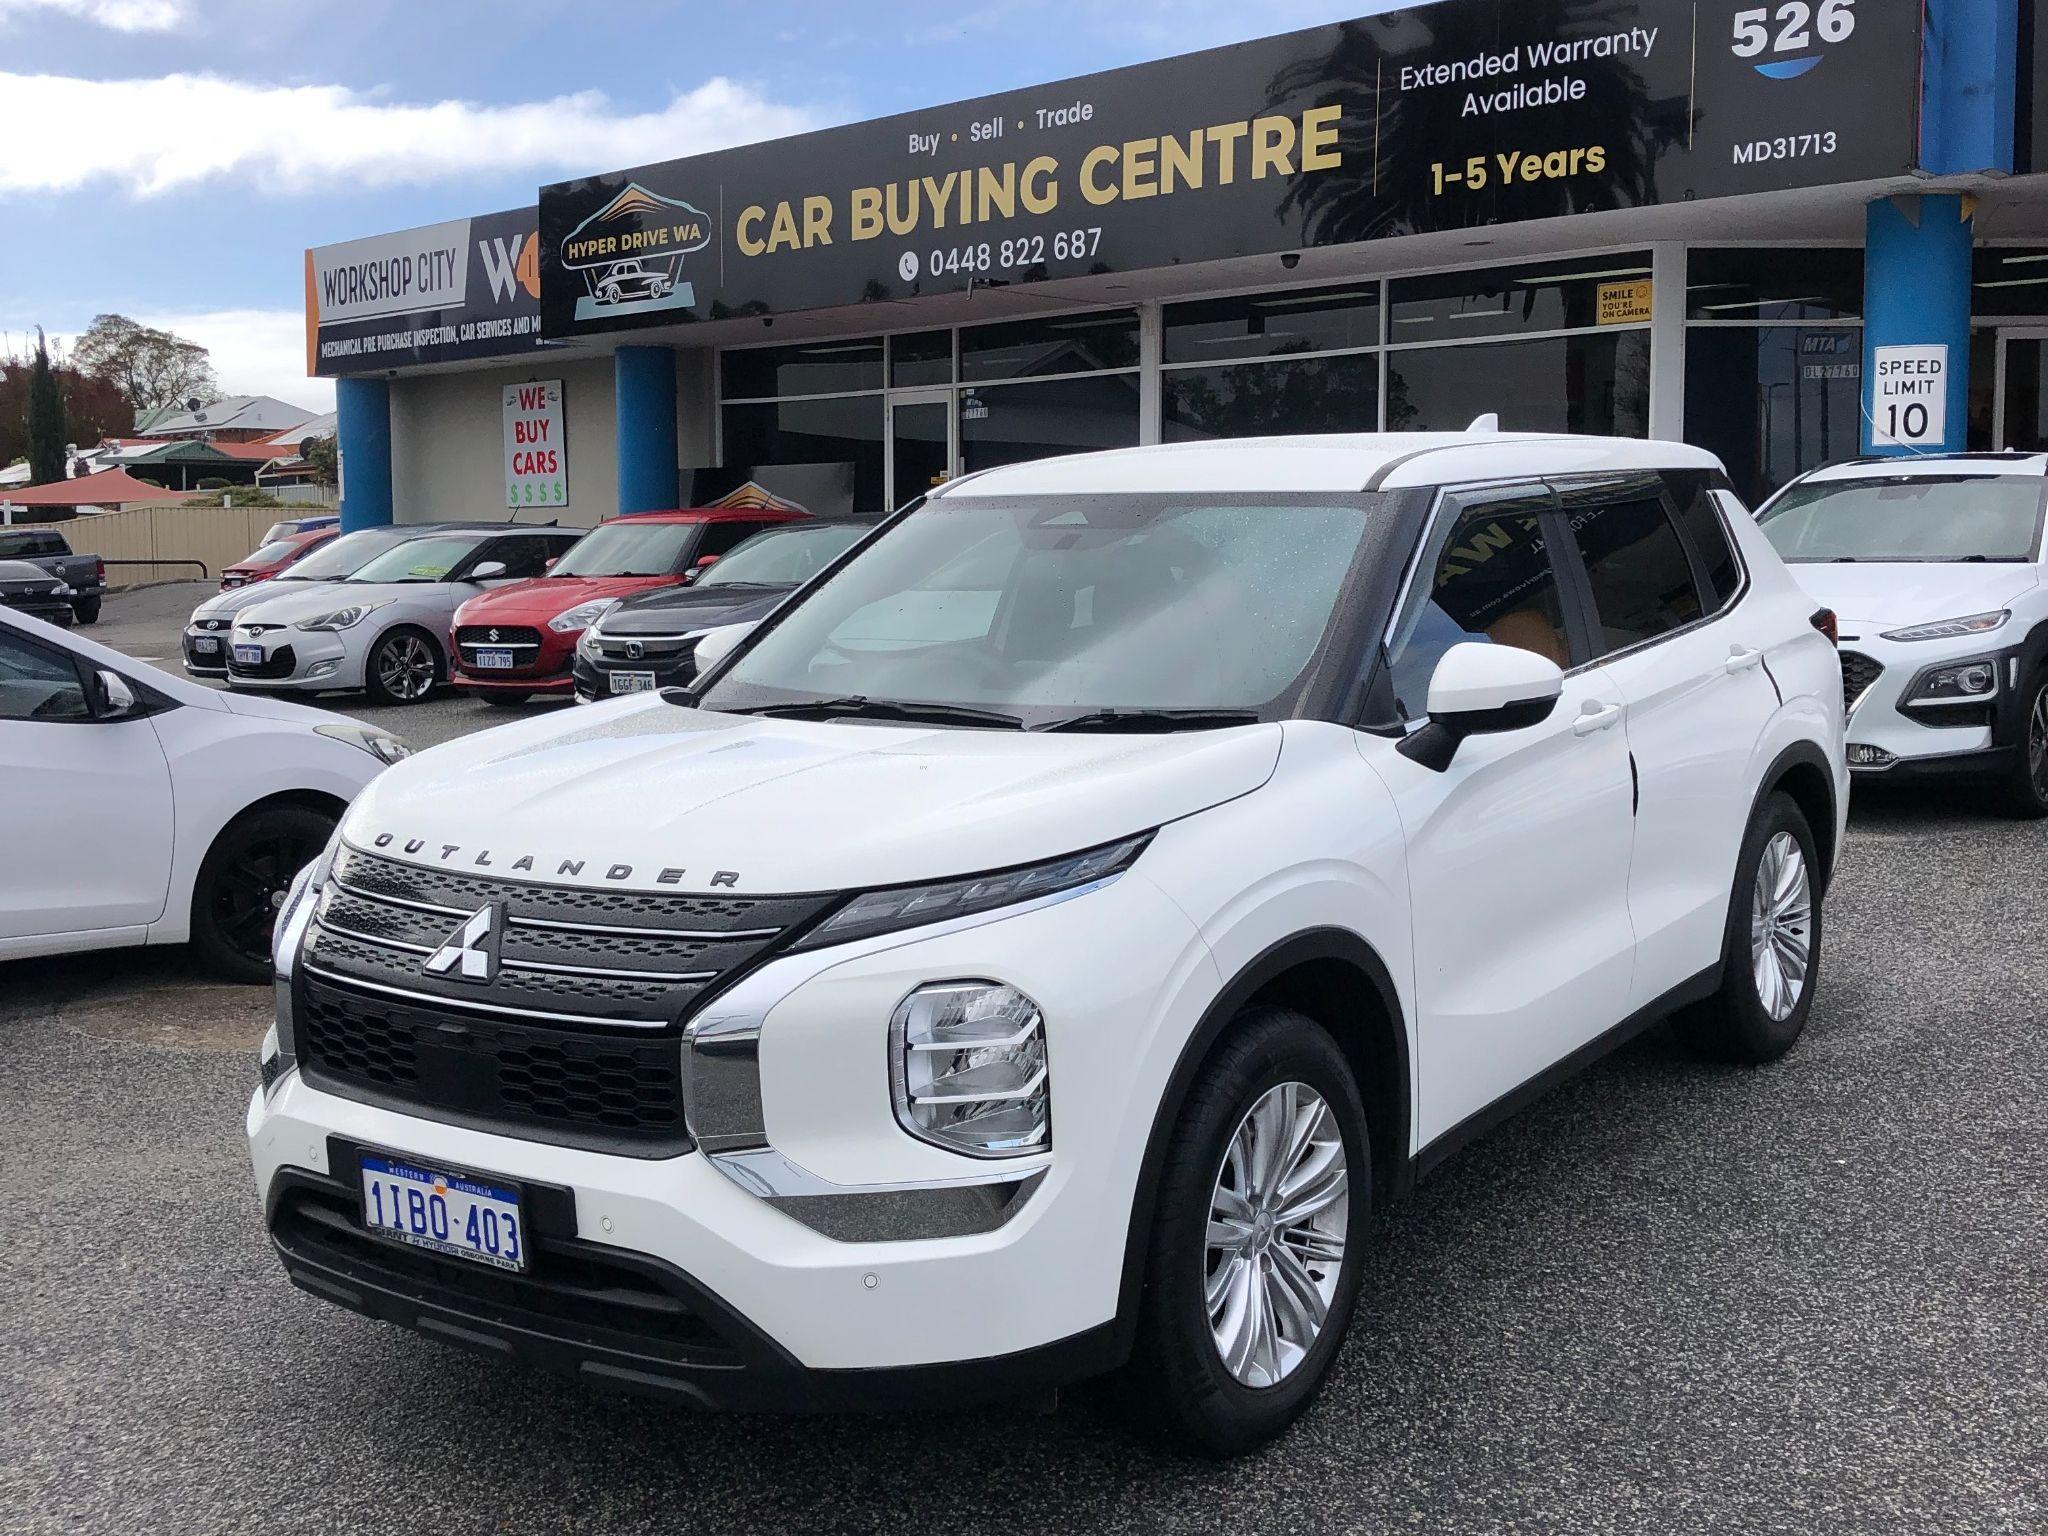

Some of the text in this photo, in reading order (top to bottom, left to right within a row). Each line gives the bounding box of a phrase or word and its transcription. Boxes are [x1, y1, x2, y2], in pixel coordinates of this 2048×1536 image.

[1731, 0, 1855, 58] 526
[1400, 26, 1658, 91] Extended Warranty
[1461, 76, 1586, 118] Available
[908, 101, 1093, 157] Buy Sell Trade
[1496, 145, 1606, 185] Years
[1733, 131, 1837, 165] MD31713
[736, 104, 1342, 257] CAR BUYING CENTRE
[568, 223, 702, 260] HYPER DRIVE WA
[930, 227, 1102, 277] 0448 822 687
[323, 247, 456, 308] WORKSHOP CITY
[1602, 289, 1634, 301] SMILE
[1602, 300, 1633, 310] YOU'RE
[1602, 307, 1650, 319] ON CAMERA
[321, 336, 362, 358] MECHANICAL
[363, 332, 377, 353] PRE
[377, 328, 412, 351] PURCHASE
[460, 321, 476, 341] CAR
[476, 317, 512, 339] SERVICES
[513, 315, 530, 335] AND
[1878, 359, 1942, 376] SPEED
[518, 386, 546, 411] WE
[1883, 379, 1935, 396] LIMIT
[514, 419, 550, 444] BUY
[1887, 402, 1929, 438] 10
[512, 449, 558, 476] CARS
[374, 832, 740, 888] OUTLANDER
[388, 1166, 492, 1197] WESTERN AUSTRALIA
[460, 1249, 495, 1264] OSBORNE
[495, 1258, 517, 1271] PARK
